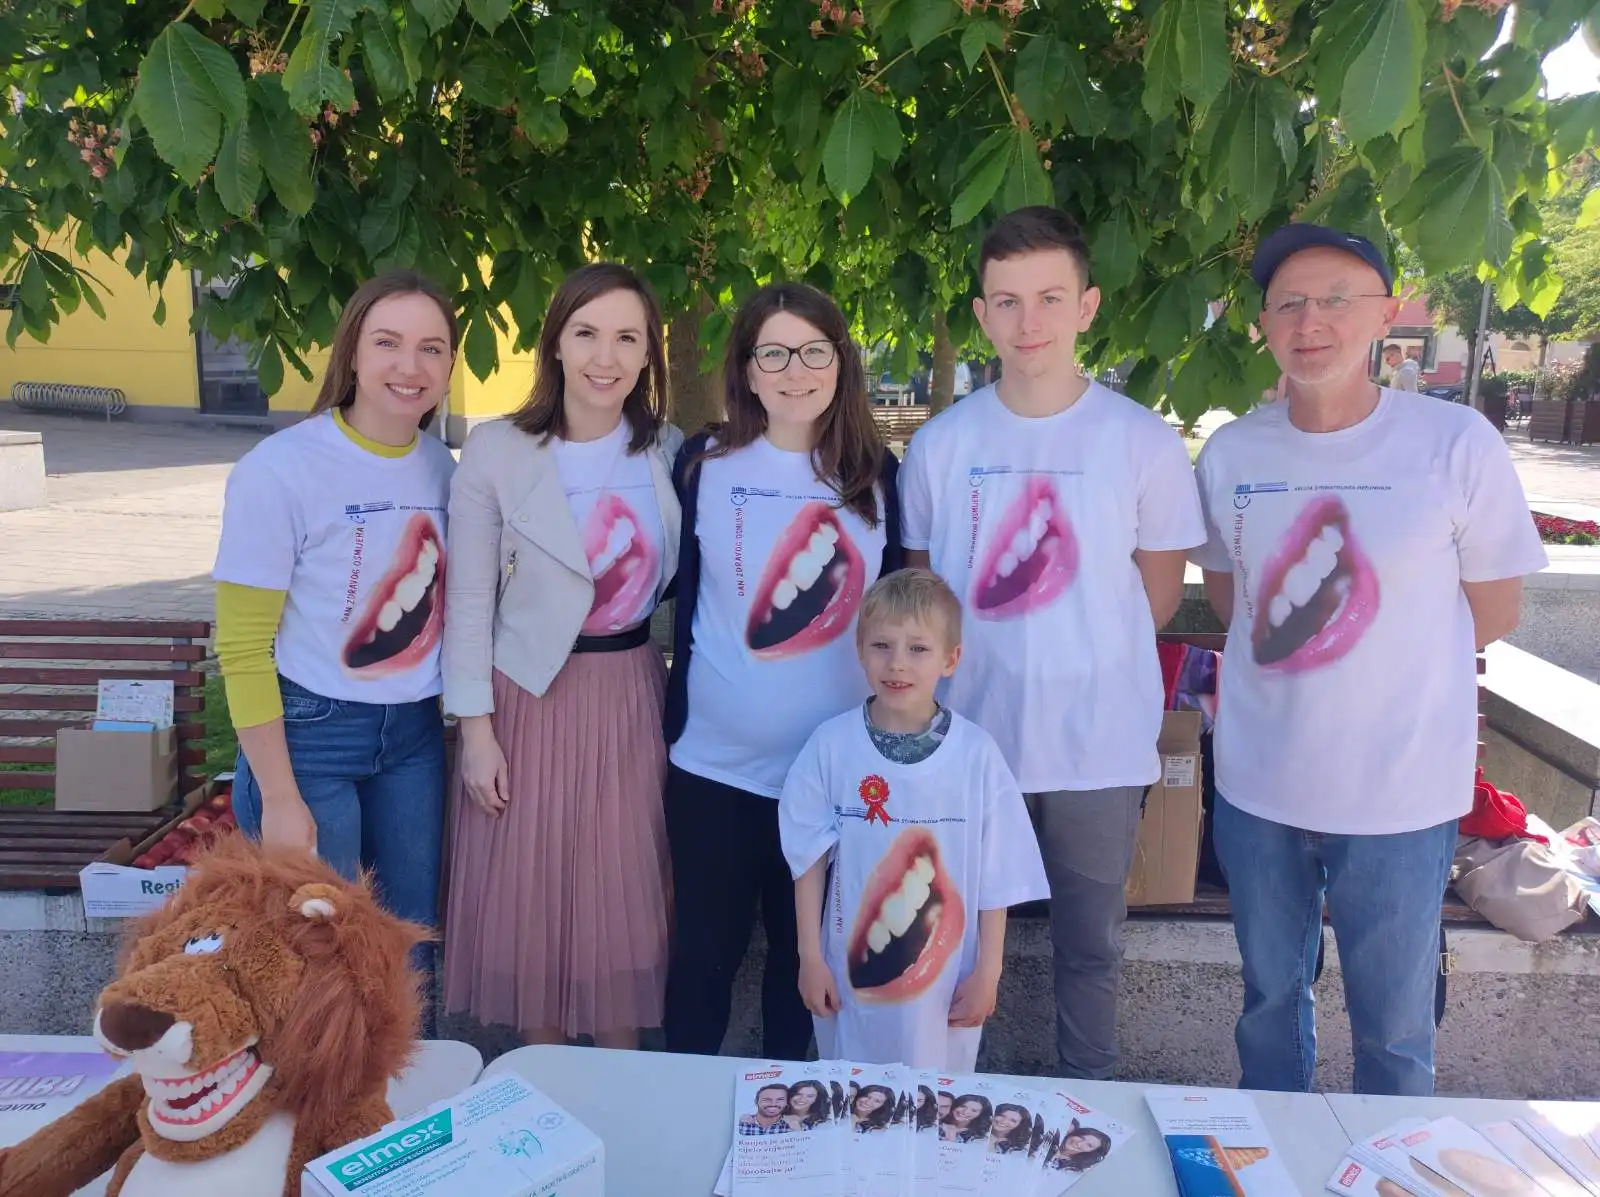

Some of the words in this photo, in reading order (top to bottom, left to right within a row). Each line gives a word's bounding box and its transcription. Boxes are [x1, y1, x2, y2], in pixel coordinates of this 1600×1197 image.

[353, 527, 365, 567] OSMIJEHA
[1234, 512, 1245, 557] OSMIJEHA
[735, 541, 744, 577] ZDRAVOG
[346, 568, 361, 605] ZDRAVOG
[341, 606, 353, 622] DAN
[141, 879, 184, 895] Regi
[341, 1122, 444, 1177] elmex
